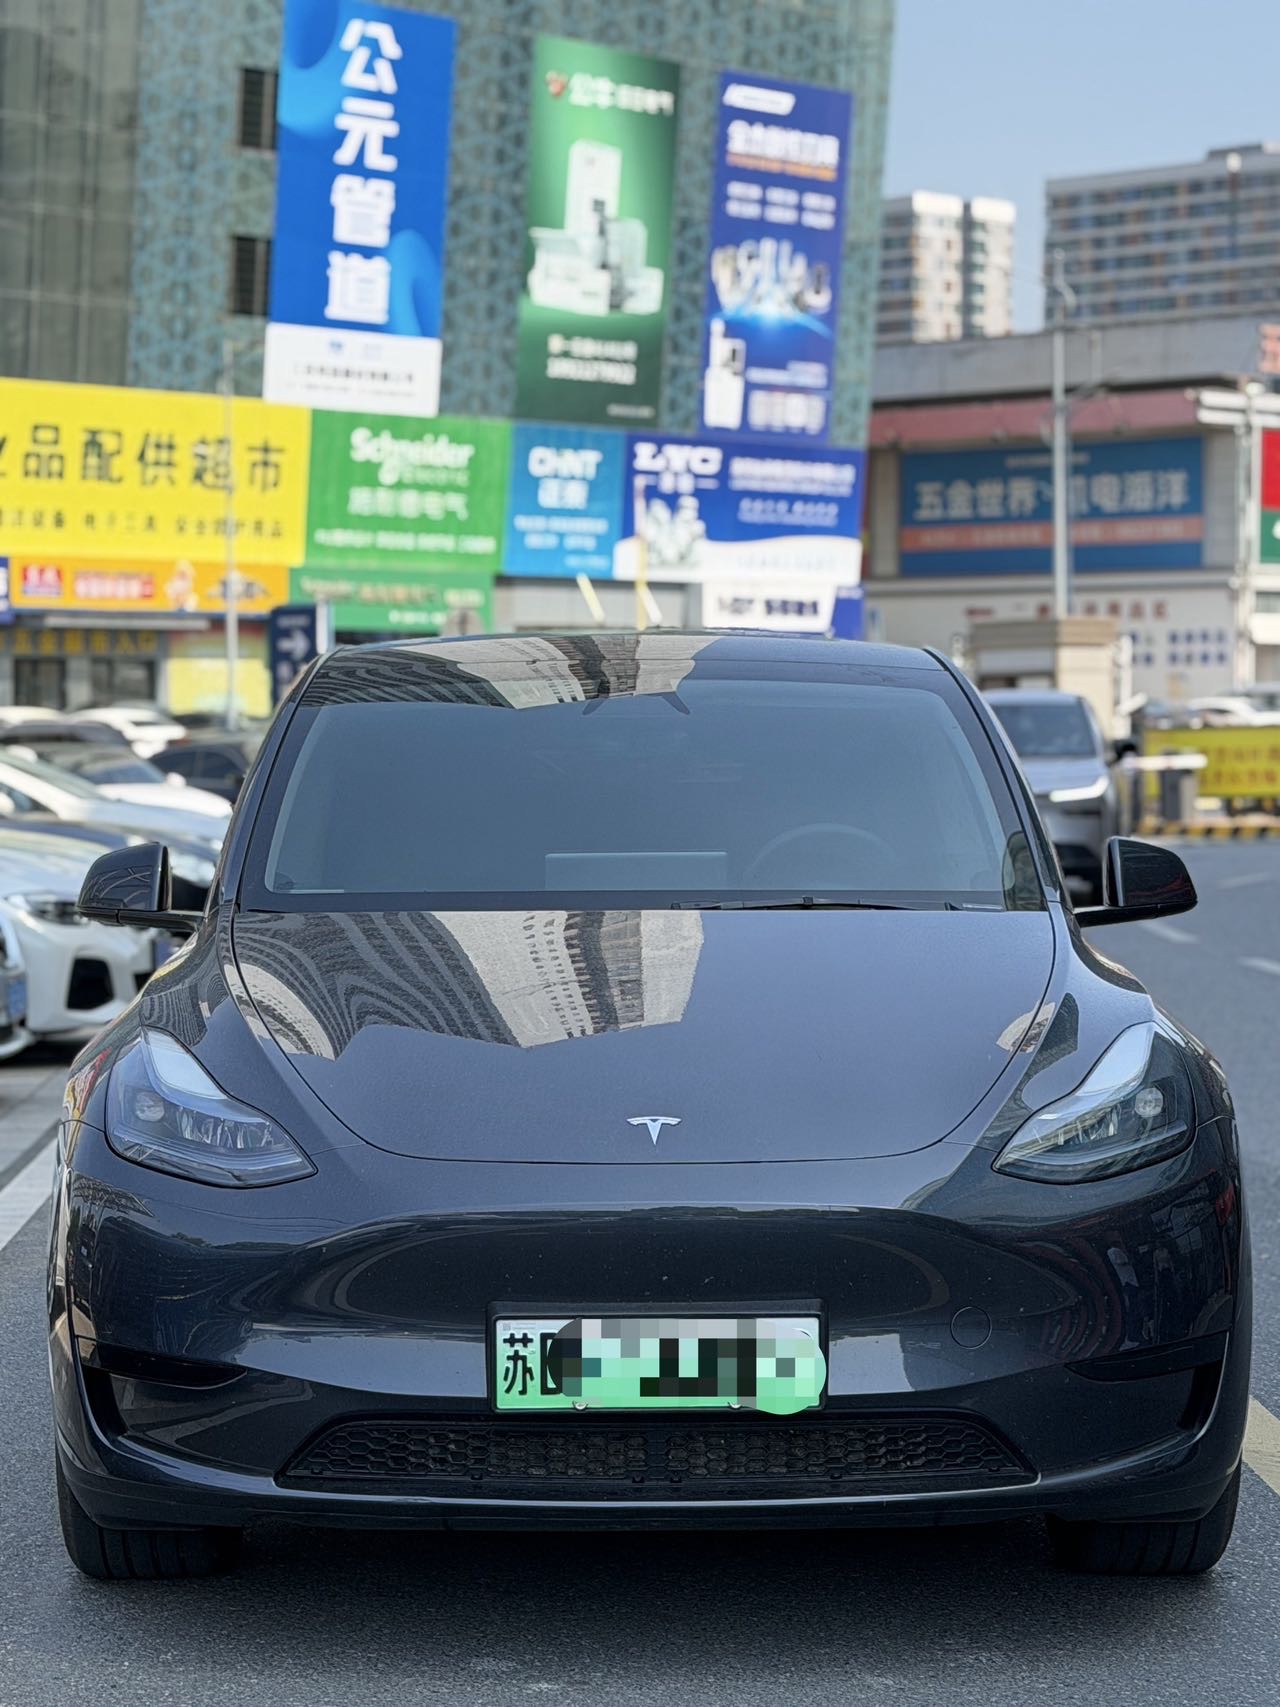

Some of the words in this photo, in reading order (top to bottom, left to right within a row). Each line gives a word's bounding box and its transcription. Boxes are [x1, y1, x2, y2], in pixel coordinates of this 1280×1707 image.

[324, 18, 403, 325] 公元管道
[0, 423, 285, 493] 品配供超市
